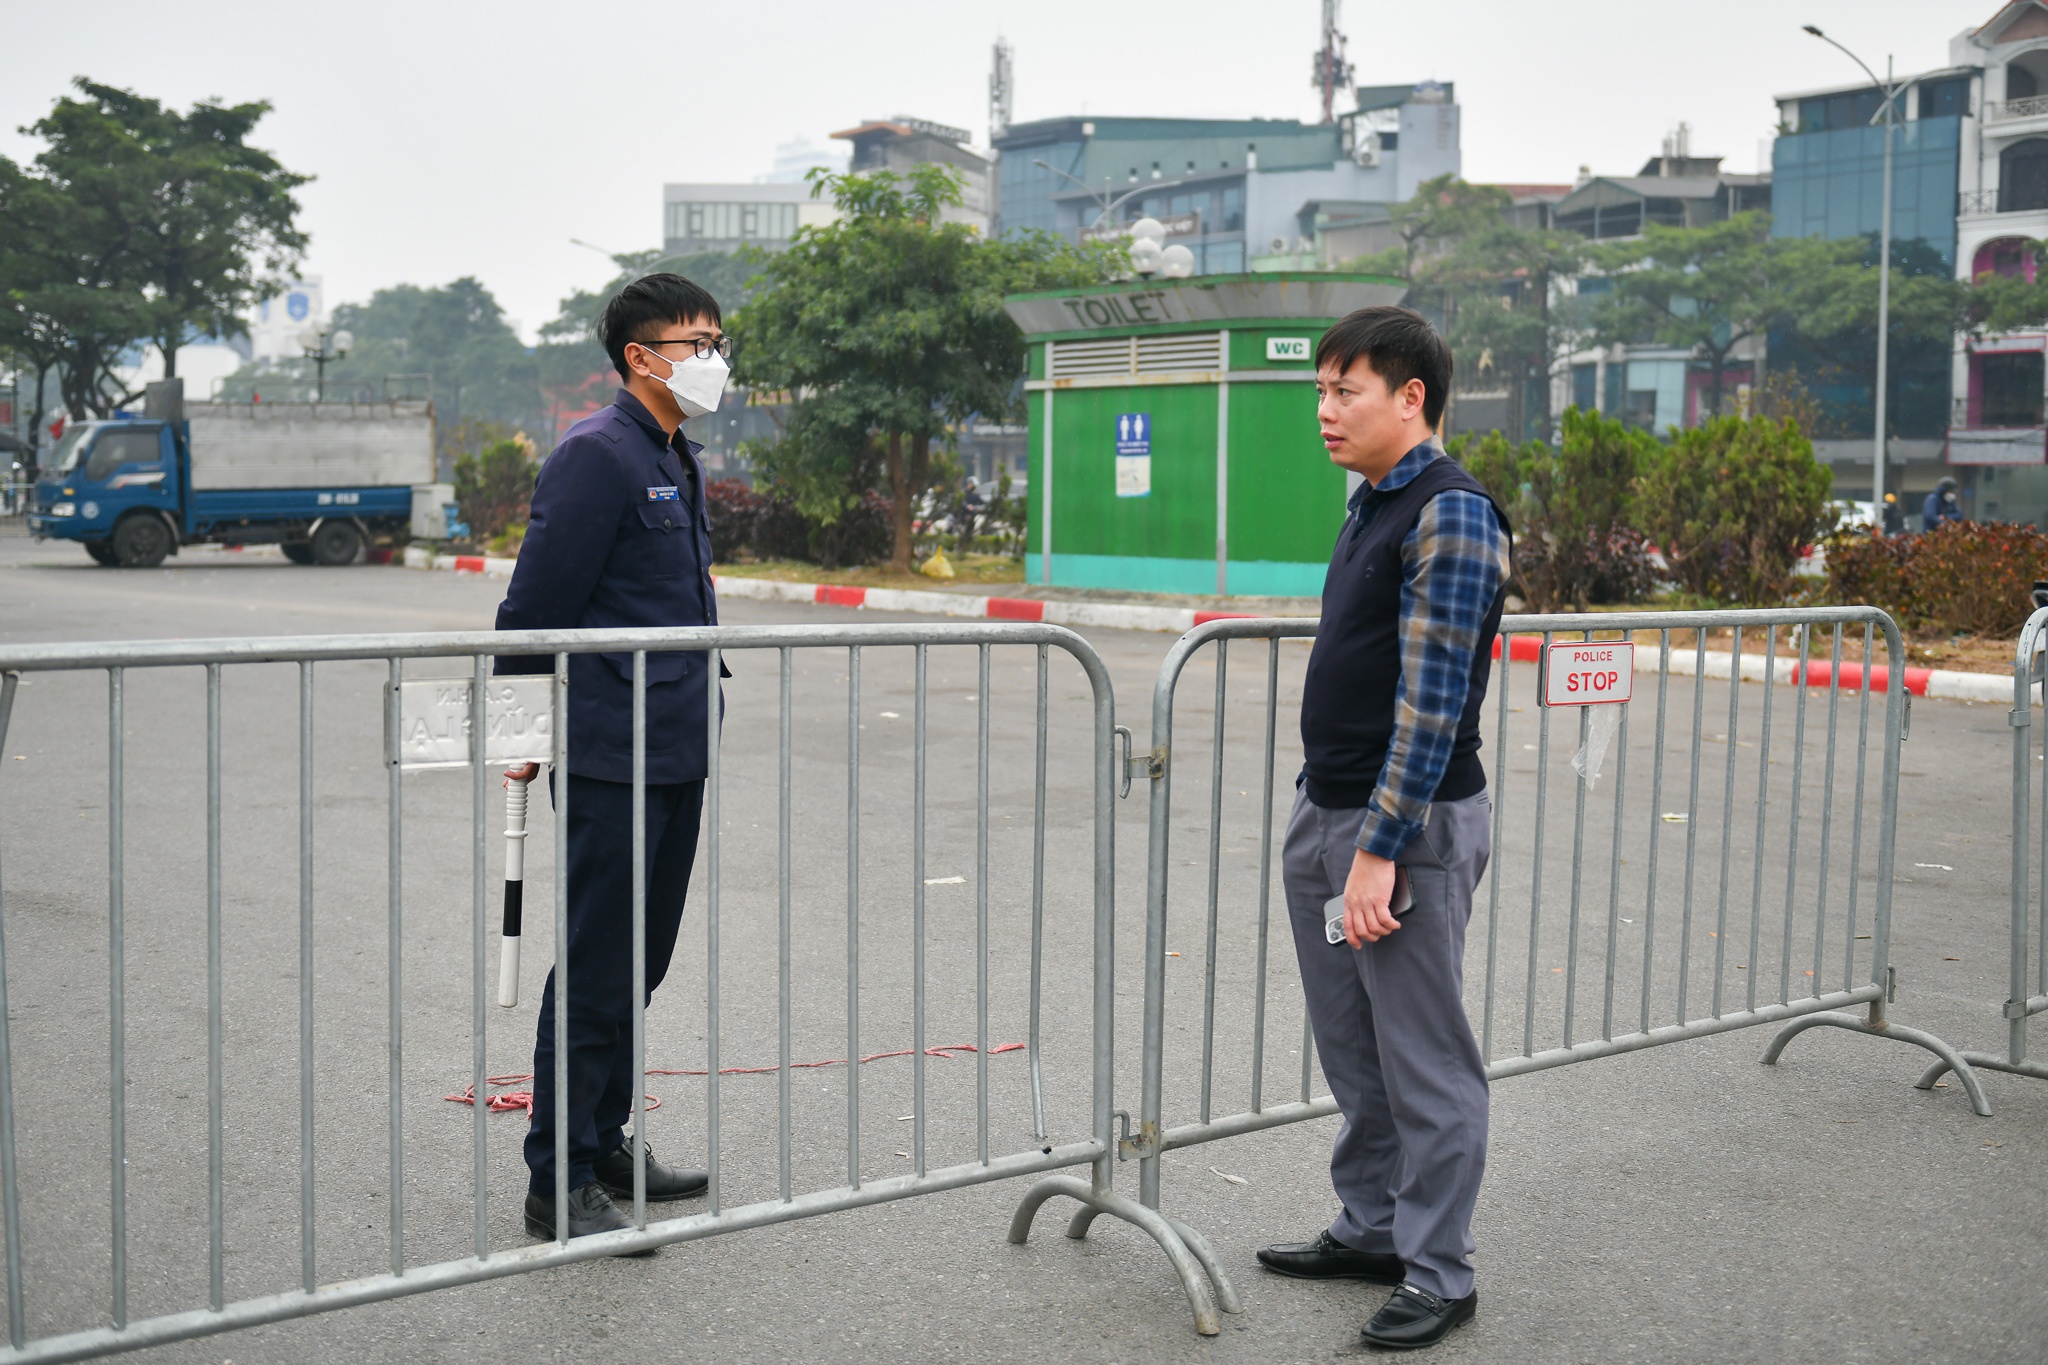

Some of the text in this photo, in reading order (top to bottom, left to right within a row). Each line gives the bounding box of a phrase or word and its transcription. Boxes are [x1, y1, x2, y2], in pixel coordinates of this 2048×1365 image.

[1062, 291, 1171, 327] TOILET
[1275, 342, 1303, 354] WC
[1574, 650, 1613, 662] POLICE
[1567, 670, 1618, 692] STOP
